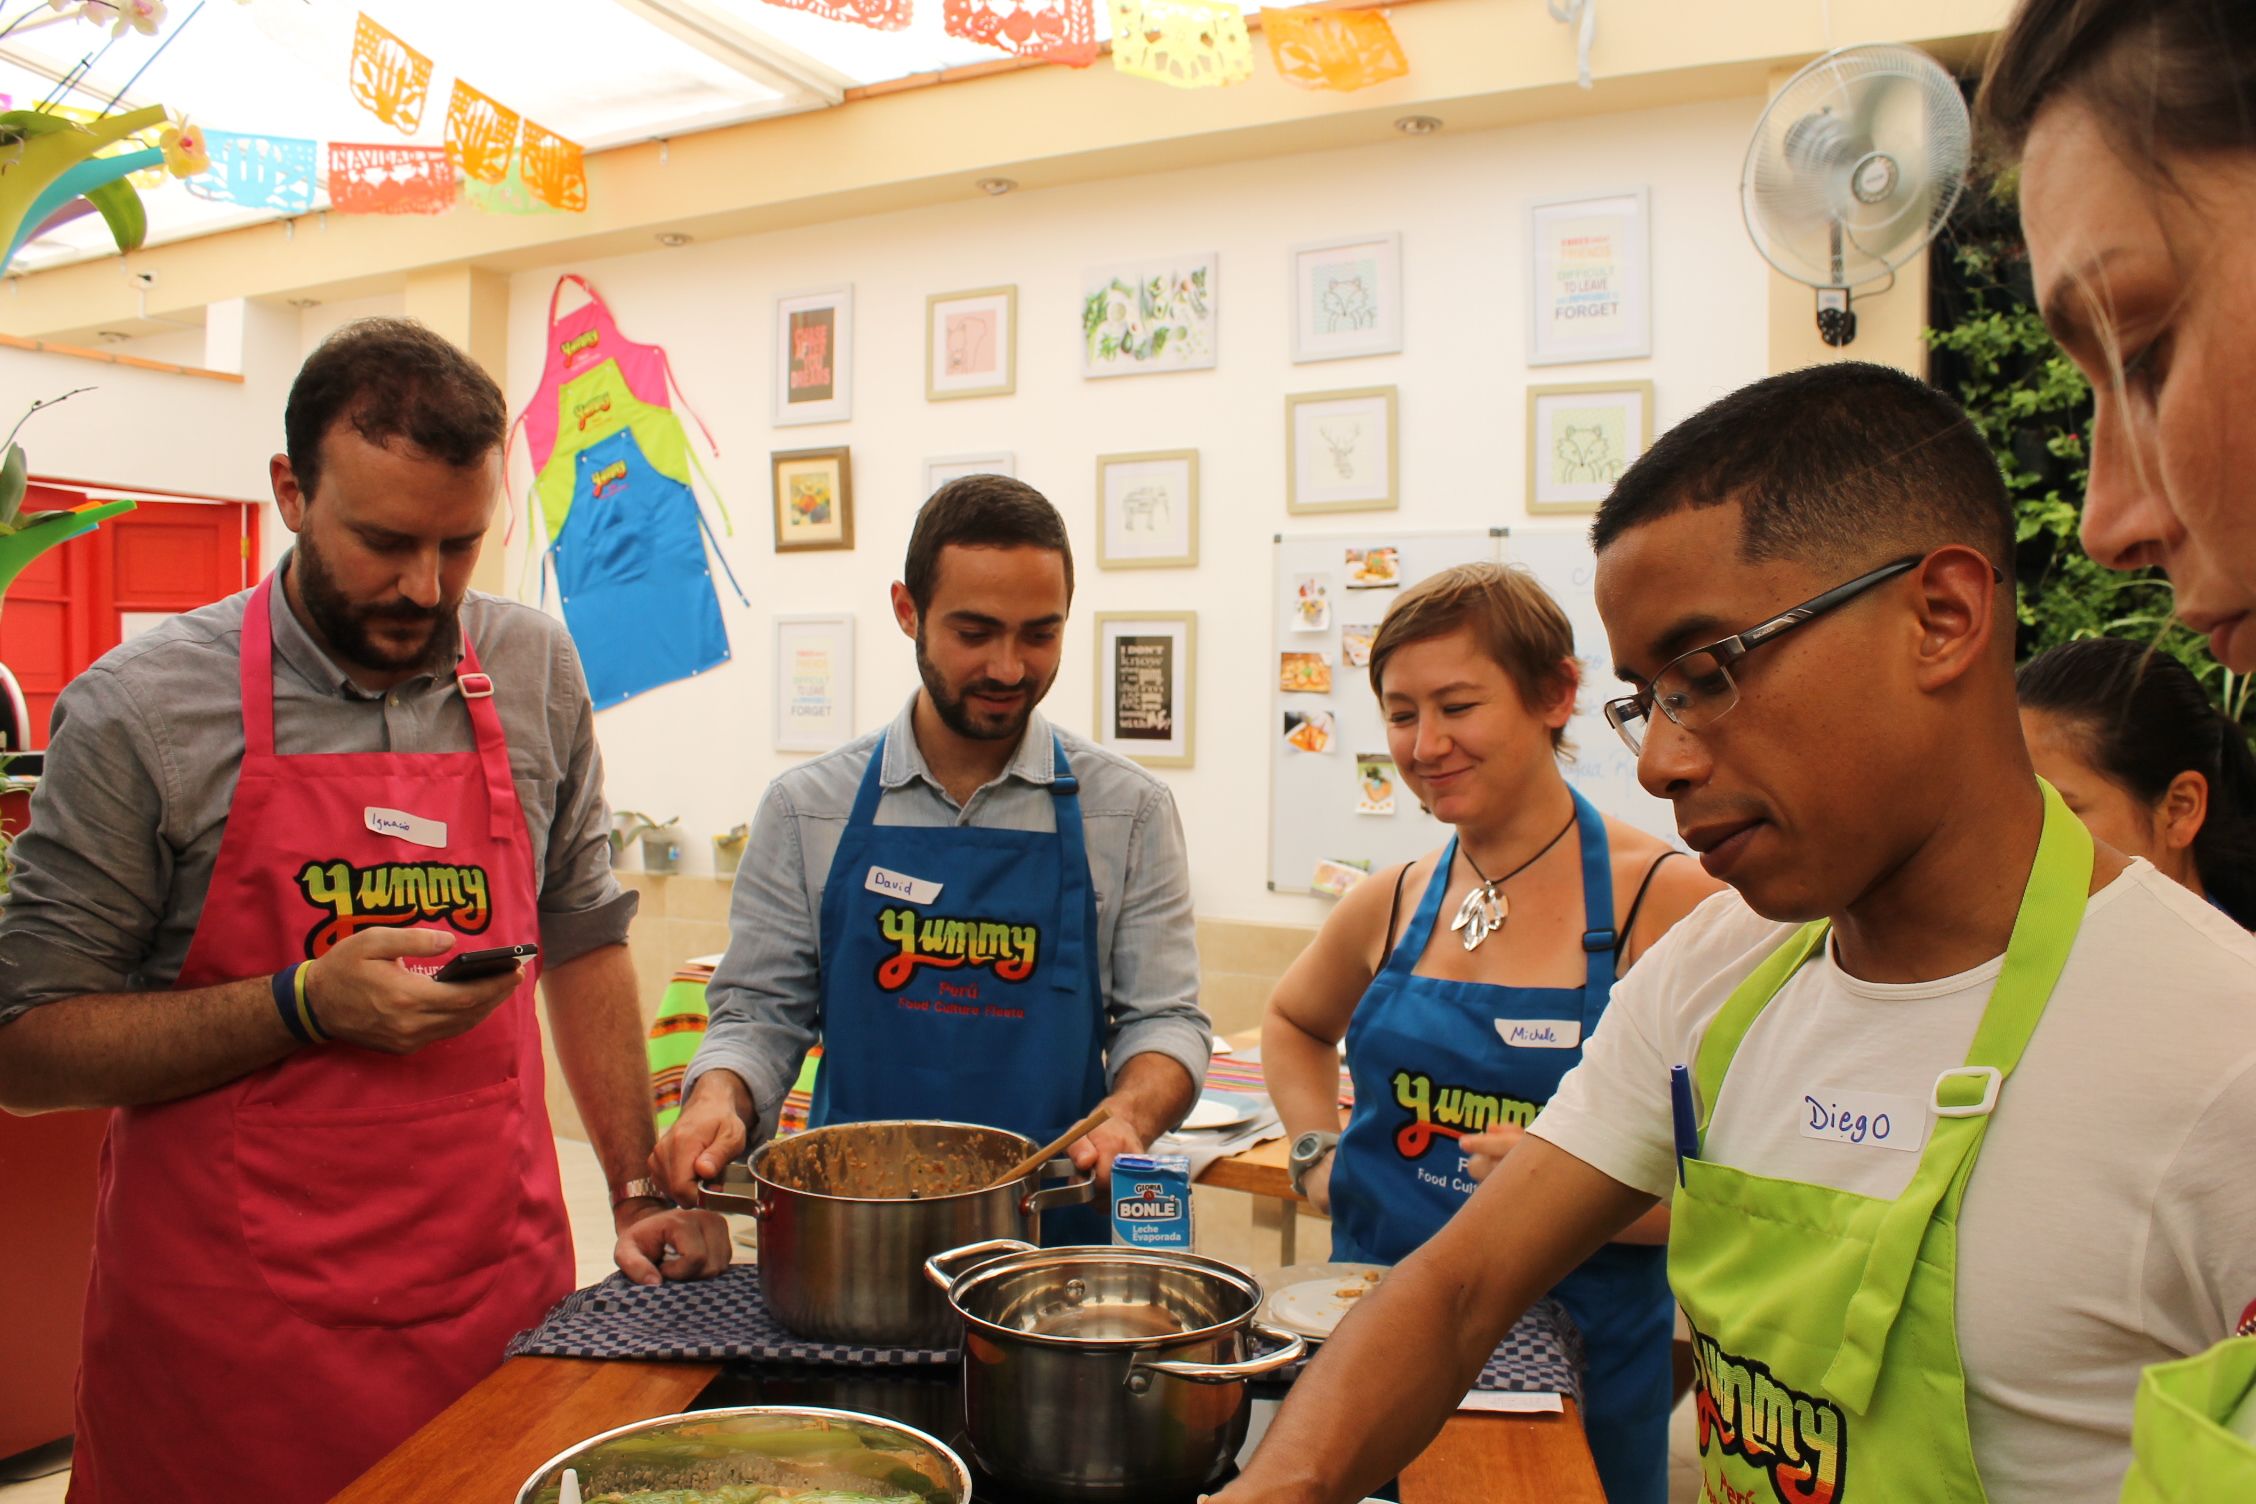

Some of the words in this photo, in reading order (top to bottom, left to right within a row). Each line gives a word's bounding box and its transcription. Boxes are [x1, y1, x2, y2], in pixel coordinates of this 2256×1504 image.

[1554, 302, 1619, 320] FORGET
[875, 872, 913, 896] David
[299, 861, 489, 961] Yummy
[877, 907, 1039, 992] Yummy
[1393, 1071, 1548, 1158] Yumm
[1804, 1095, 1890, 1143] Diego
[1418, 1167, 1447, 1188] Food
[1132, 1224, 1159, 1233] Leche
[1132, 1232, 1182, 1243] Evaporada
